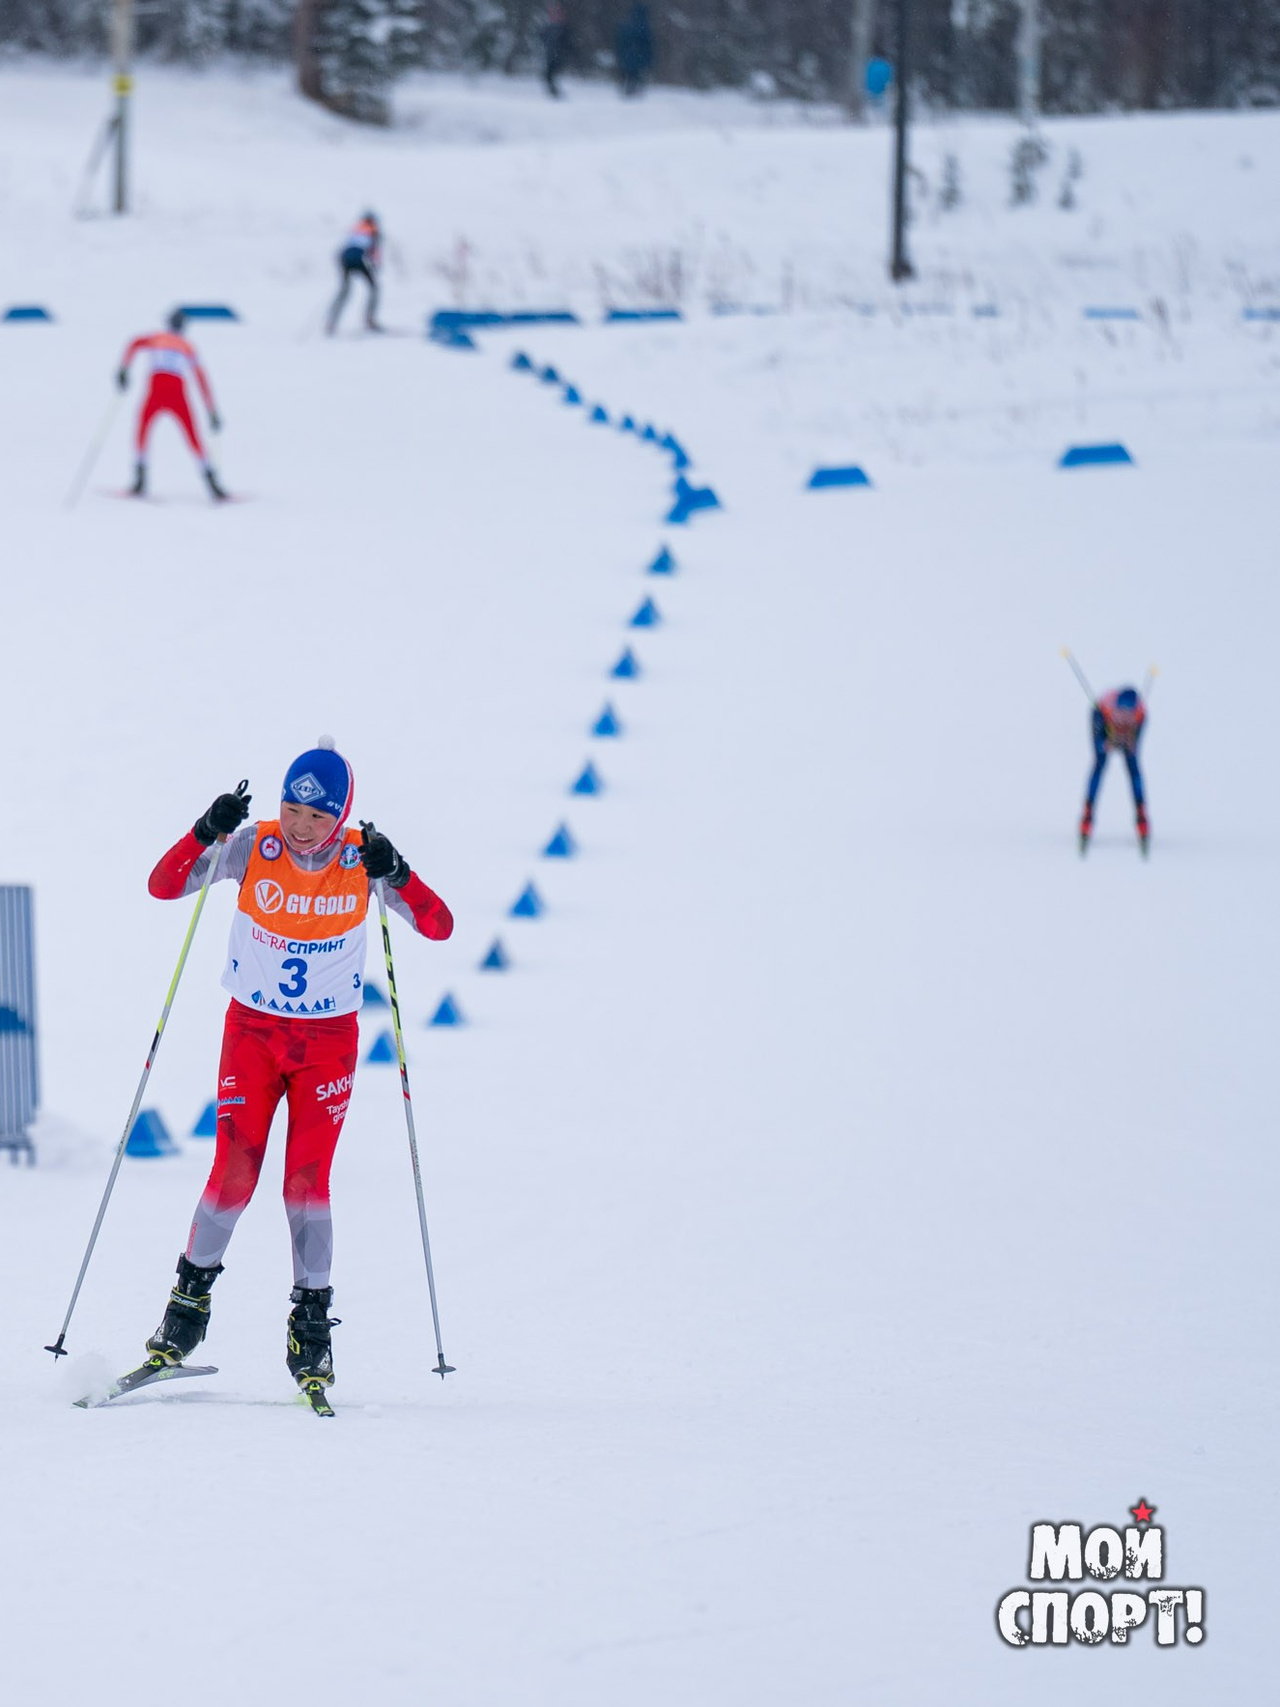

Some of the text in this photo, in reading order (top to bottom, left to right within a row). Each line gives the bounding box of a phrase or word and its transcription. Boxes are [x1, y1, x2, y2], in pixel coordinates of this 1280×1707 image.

[285, 893, 357, 916] GV GOLD
[278, 957, 308, 998] 3
[352, 972, 362, 989] 3
